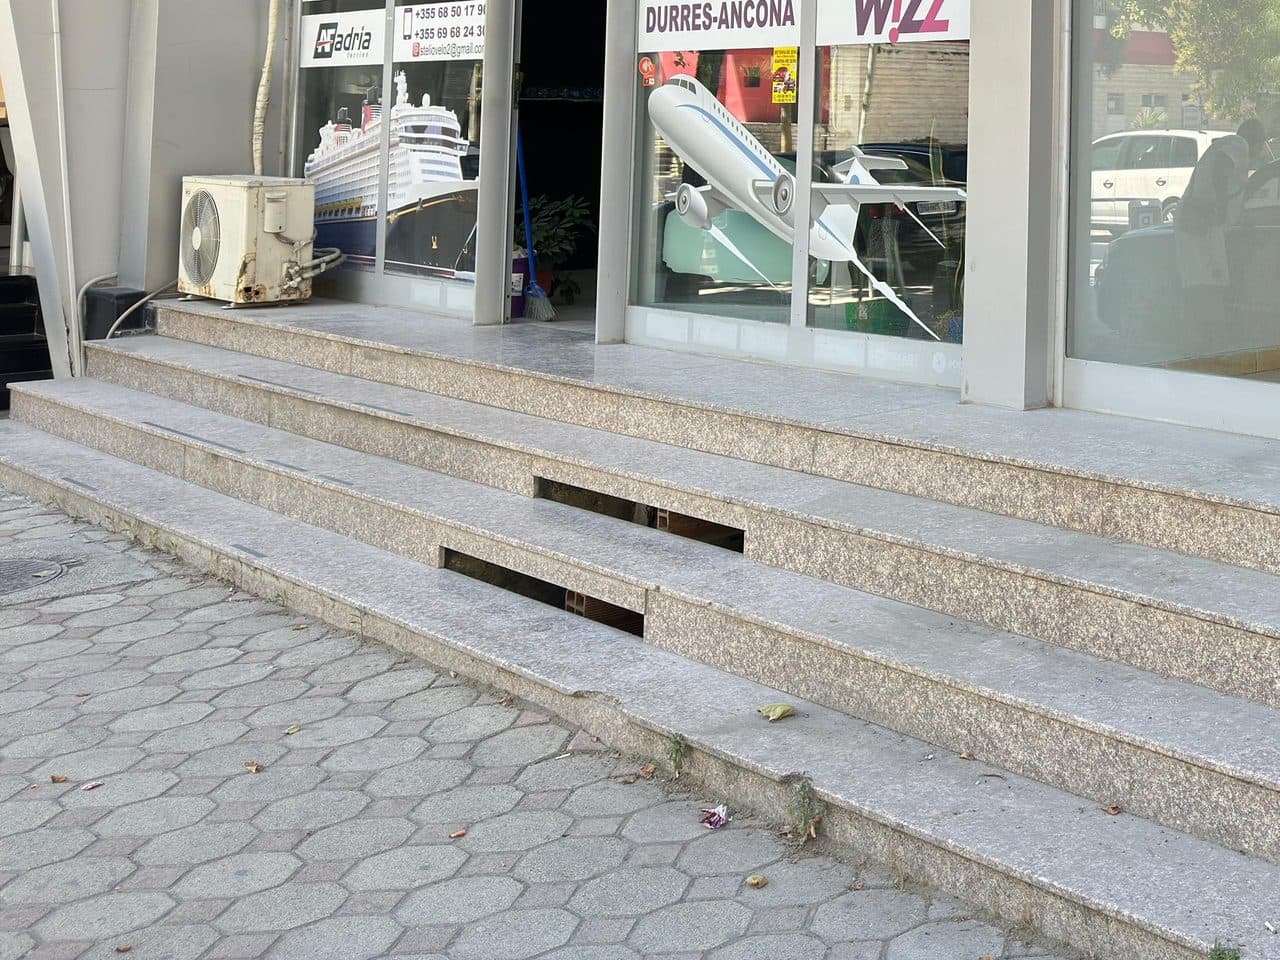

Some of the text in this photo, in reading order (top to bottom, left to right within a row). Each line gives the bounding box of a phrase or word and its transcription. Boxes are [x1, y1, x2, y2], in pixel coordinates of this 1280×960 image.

[416, 8, 436, 19] +355
[438, 6, 449, 18] 68
[451, 6, 462, 17] 50
[464, 5, 475, 16] 17
[334, 26, 372, 51] adria
[415, 27, 435, 40] +355
[437, 27, 448, 39] 69
[450, 26, 460, 38] 68
[463, 25, 474, 38] 24
